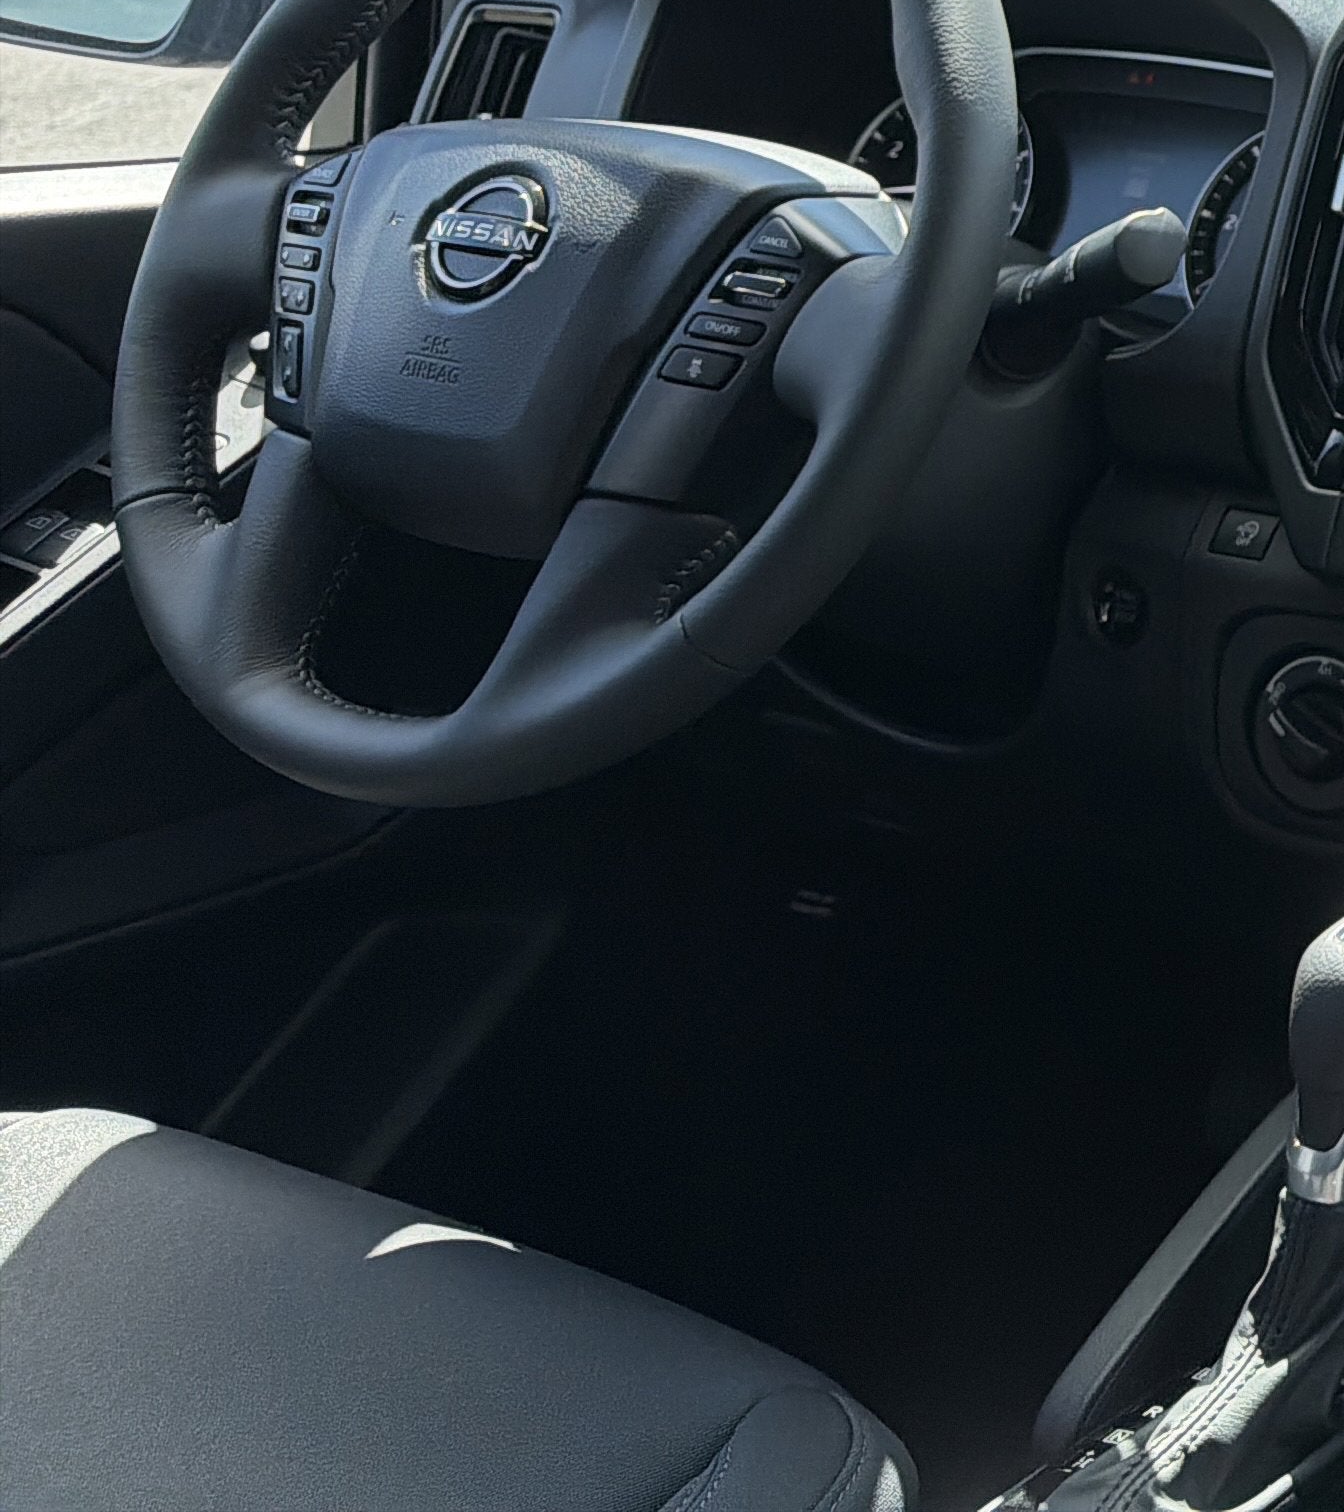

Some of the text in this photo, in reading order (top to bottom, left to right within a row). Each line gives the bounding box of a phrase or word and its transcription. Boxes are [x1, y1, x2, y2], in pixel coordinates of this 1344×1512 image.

[432, 219, 539, 253] NISSAN
[758, 235, 789, 249] CANCEL
[421, 335, 451, 355] SRS
[401, 358, 460, 384] AIRBAG
